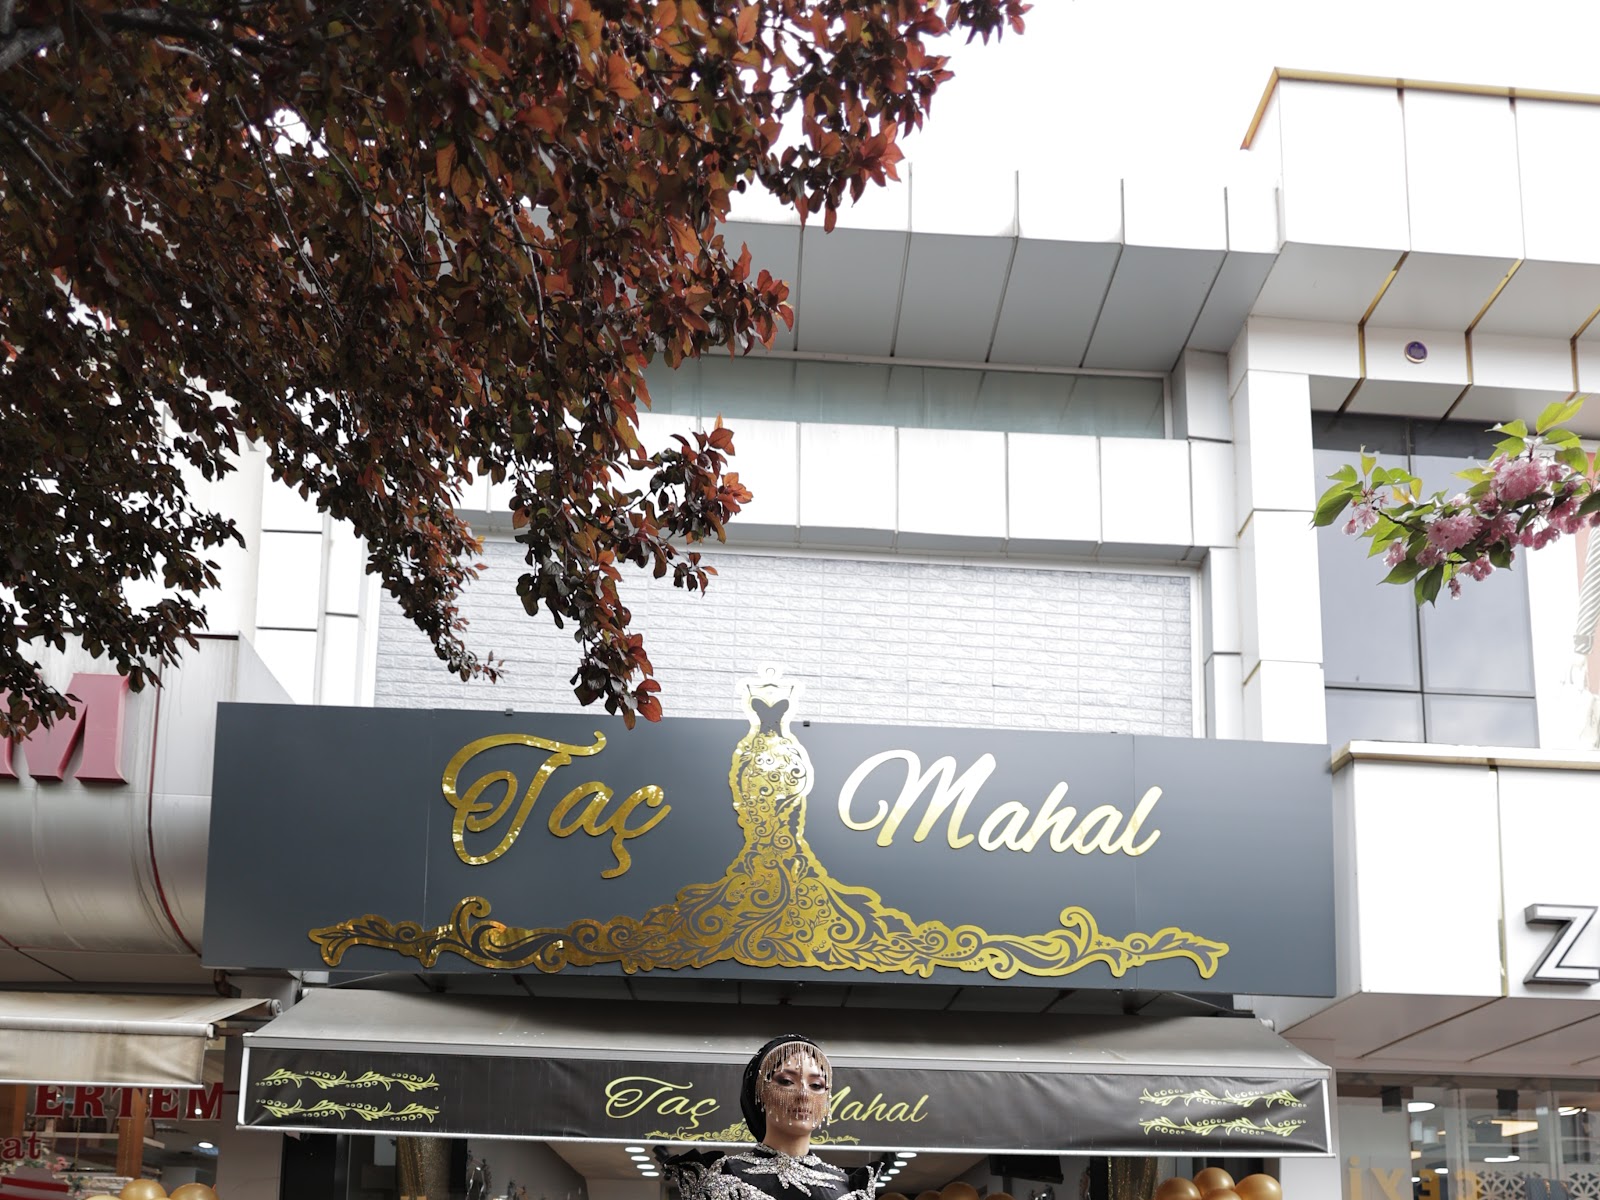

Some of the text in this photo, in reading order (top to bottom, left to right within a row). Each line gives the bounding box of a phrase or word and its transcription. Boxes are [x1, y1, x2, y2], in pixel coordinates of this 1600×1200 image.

[442, 731, 1164, 879] Taç Mahal
[1523, 903, 1600, 986] Z
[32, 1083, 223, 1121] ERTEM
[604, 1075, 720, 1130] Taç
[0, 1131, 42, 1160] at
